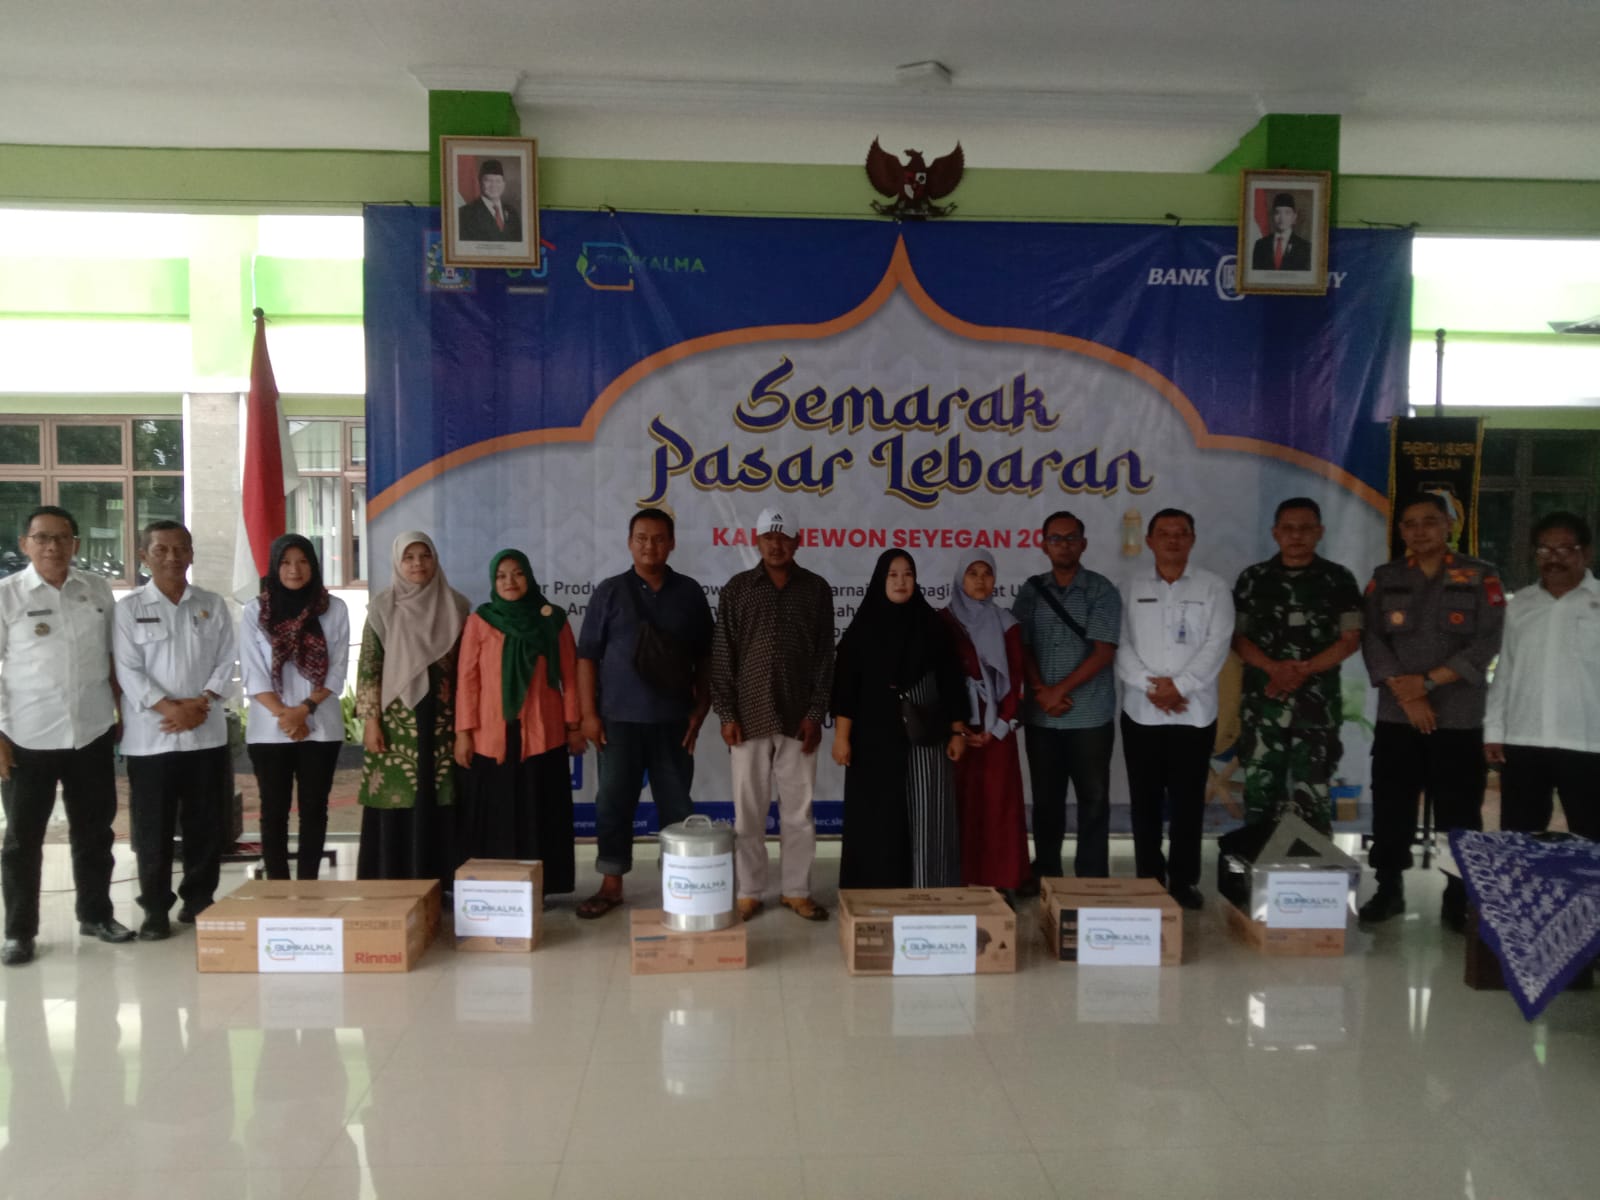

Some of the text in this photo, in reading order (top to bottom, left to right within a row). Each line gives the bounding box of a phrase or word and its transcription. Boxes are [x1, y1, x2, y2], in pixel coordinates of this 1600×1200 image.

[1147, 268, 1210, 286] BANK
[733, 355, 1060, 435] Semarak
[639, 414, 1154, 509] Pasar Lebaran
[893, 529, 1010, 548] SEYEGAN
[355, 952, 402, 964] Rinnai
